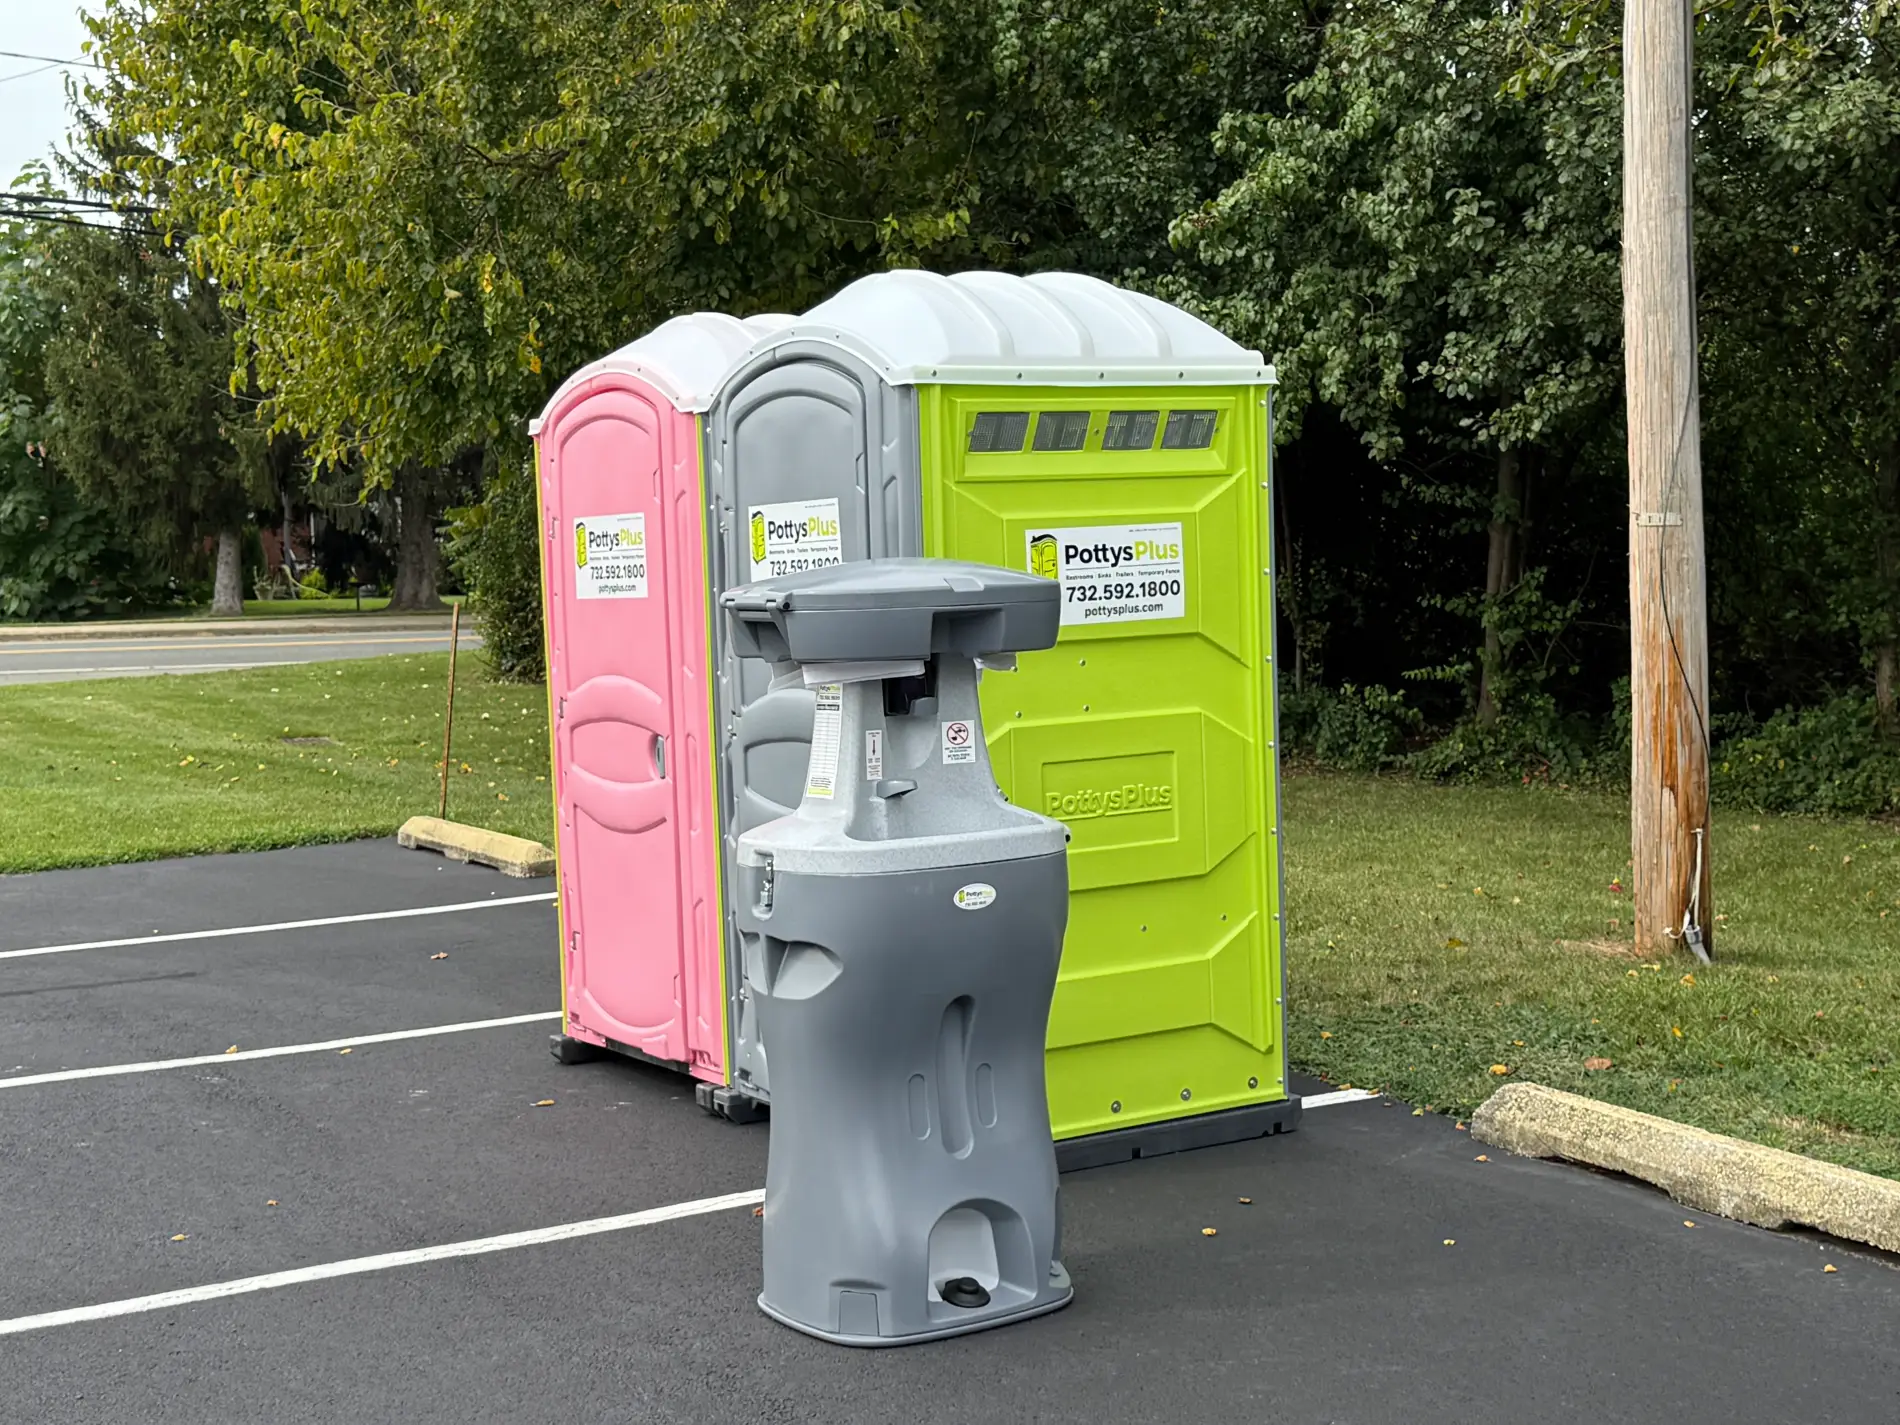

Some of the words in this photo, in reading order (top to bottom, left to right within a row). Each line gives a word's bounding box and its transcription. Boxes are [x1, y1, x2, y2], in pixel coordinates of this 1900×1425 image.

[588, 528, 643, 551] PottysPlus
[768, 516, 838, 544] PottysPlus
[1064, 540, 1180, 568] PottysPlus
[590, 563, 645, 580] 732.592.1800
[769, 556, 840, 577] 732.592180
[1138, 569, 1164, 577] Temporary
[598, 583, 637, 595] pottysplus.com
[1066, 579, 1181, 603] 732.592.1800
[1084, 602, 1163, 618] pottysplus.com
[1045, 783, 1172, 818] PottysPlus
